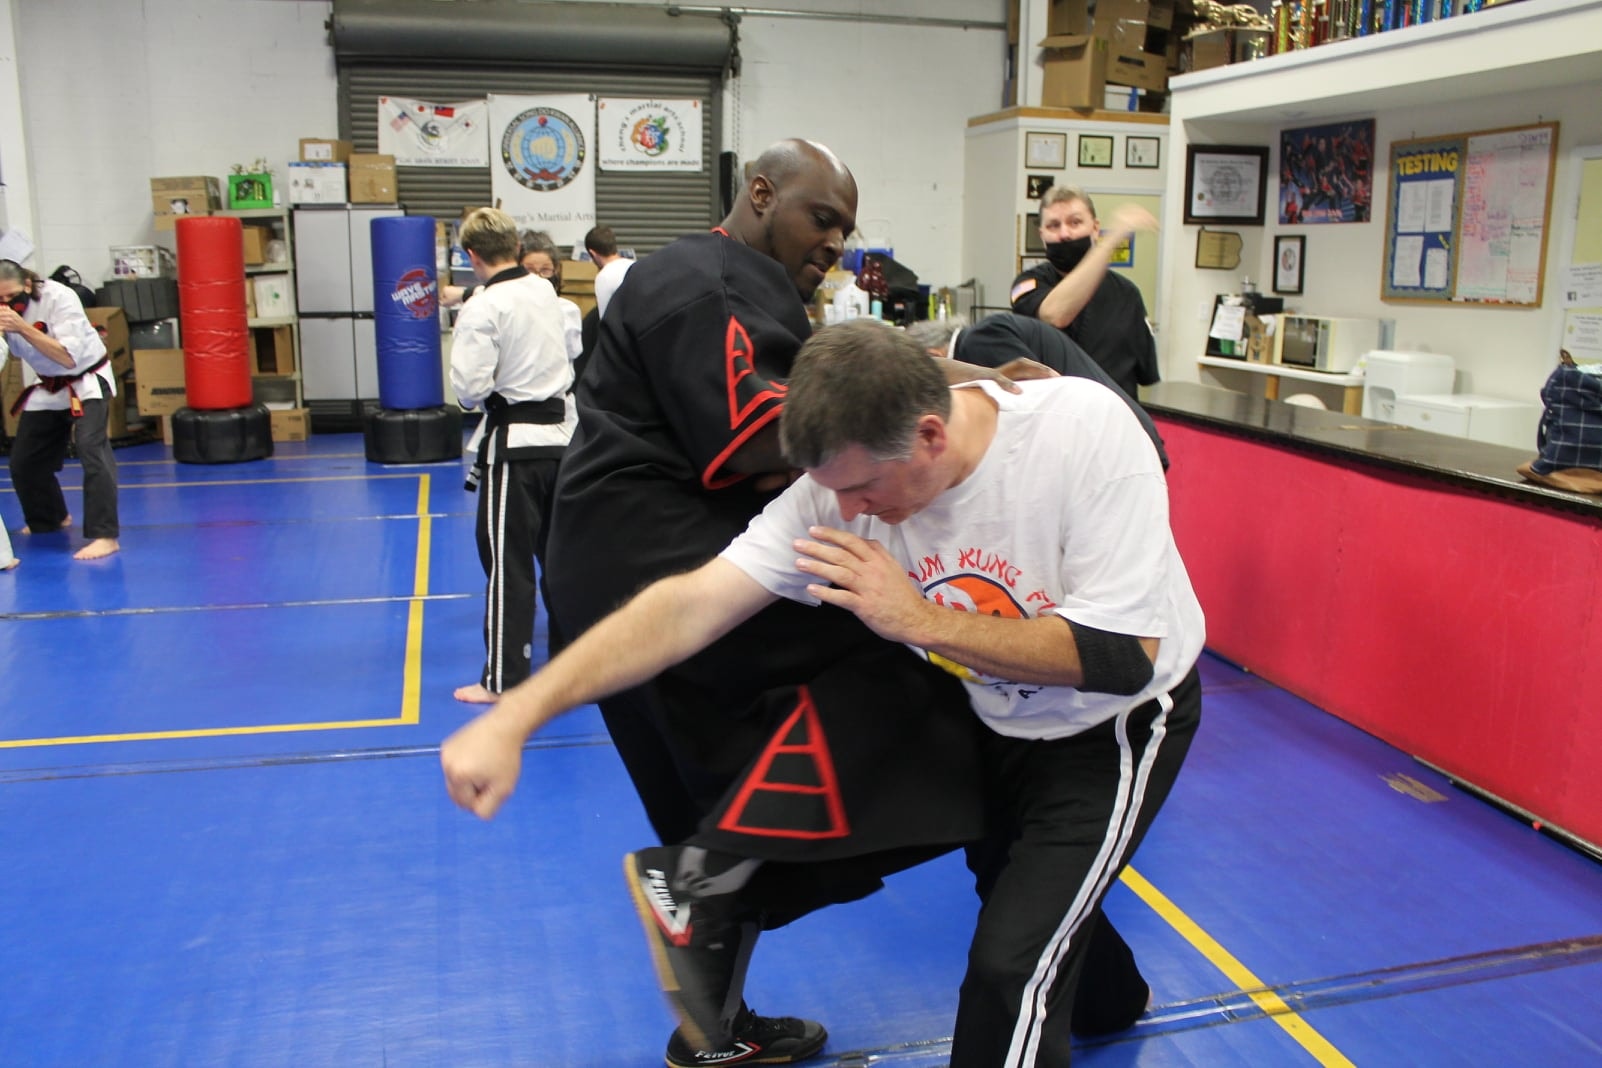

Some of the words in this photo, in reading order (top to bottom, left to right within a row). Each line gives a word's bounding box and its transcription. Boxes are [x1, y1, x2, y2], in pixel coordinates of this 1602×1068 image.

[626, 159, 666, 167] champions
[1396, 152, 1459, 176] TESTING
[538, 211, 571, 221] Martial
[577, 211, 593, 221] Arts
[958, 547, 1022, 587] KUNG
